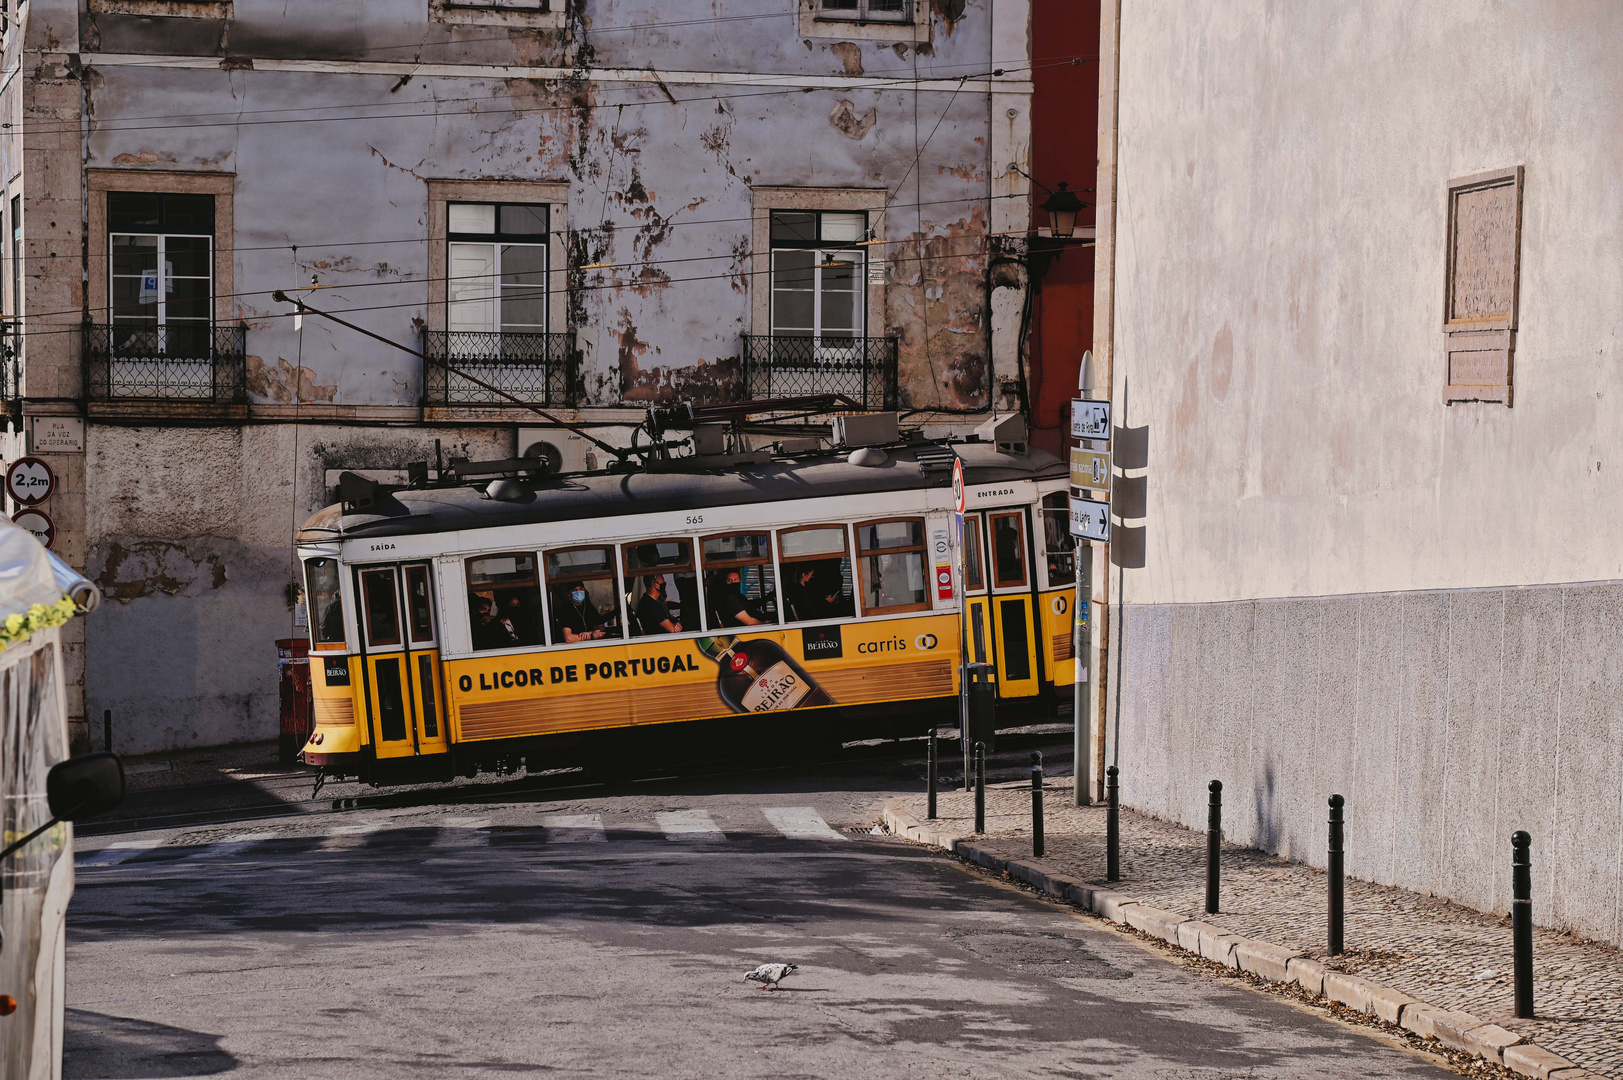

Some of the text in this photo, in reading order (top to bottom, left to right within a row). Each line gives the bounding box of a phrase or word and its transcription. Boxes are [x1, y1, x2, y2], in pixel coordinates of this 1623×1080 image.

[15, 473, 49, 488] 2,2m
[977, 488, 1015, 498] ENTRADA
[686, 515, 704, 525] 565
[370, 543, 396, 551] SAÍDA
[807, 640, 838, 651] BEIRÃO
[857, 635, 906, 654] carris
[326, 668, 347, 677] BEIRÃO
[459, 653, 700, 692] O LICOR DE PORTUGAL
